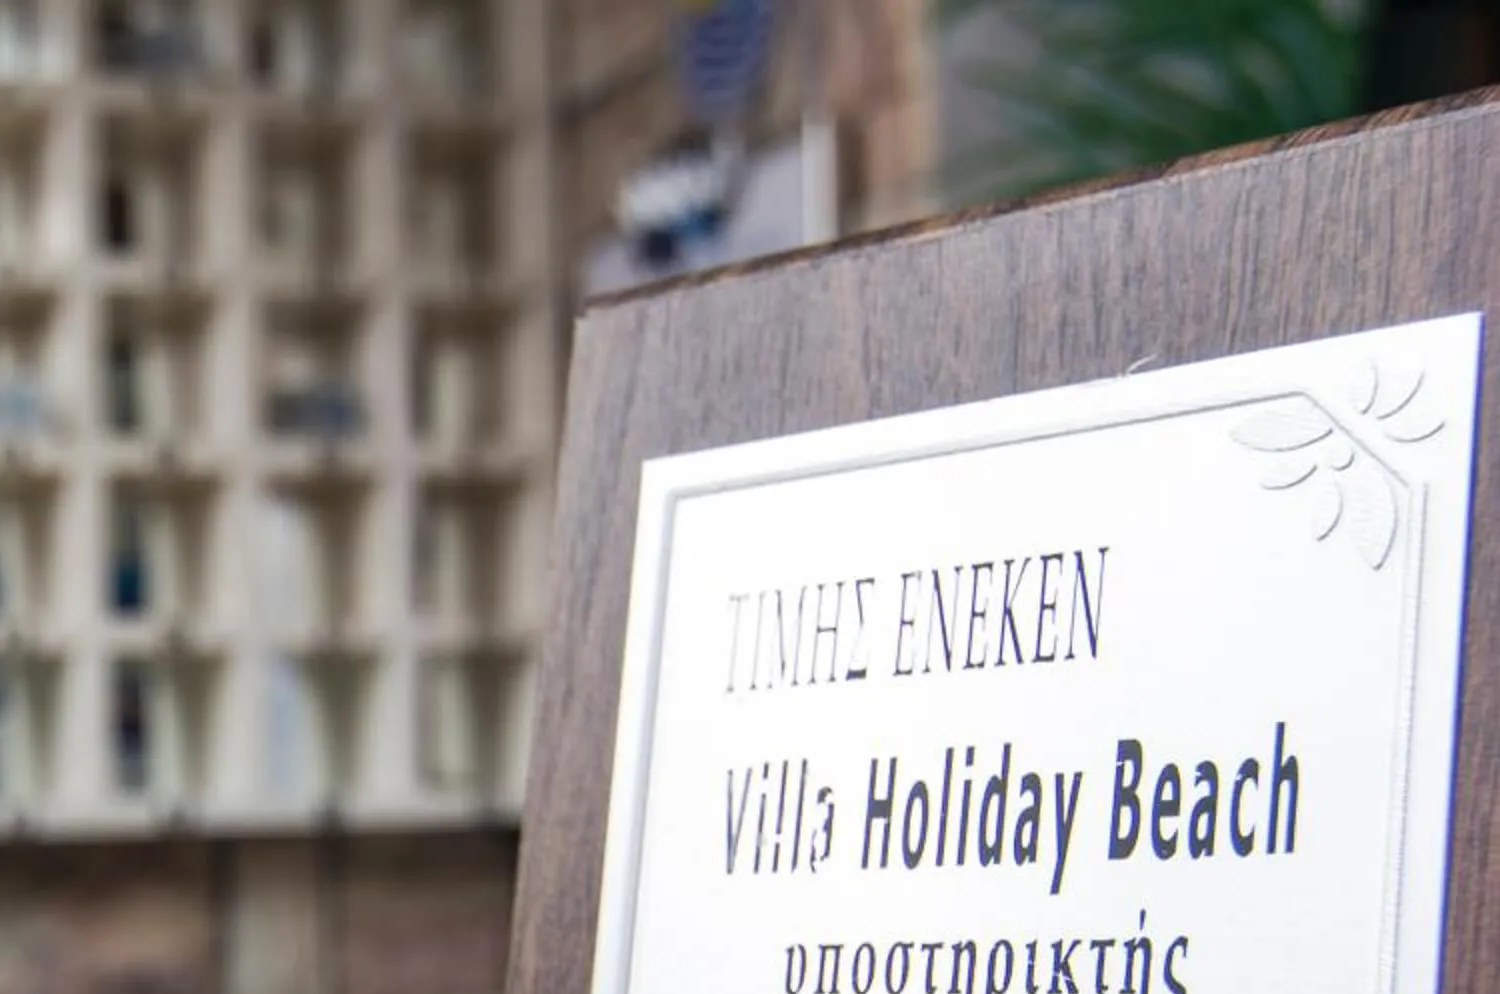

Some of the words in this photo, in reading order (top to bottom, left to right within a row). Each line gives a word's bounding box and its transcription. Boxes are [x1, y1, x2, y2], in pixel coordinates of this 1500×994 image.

[725, 757, 836, 875] Villa
[860, 741, 1084, 896] Holiday
[1107, 720, 1300, 861] Beach
